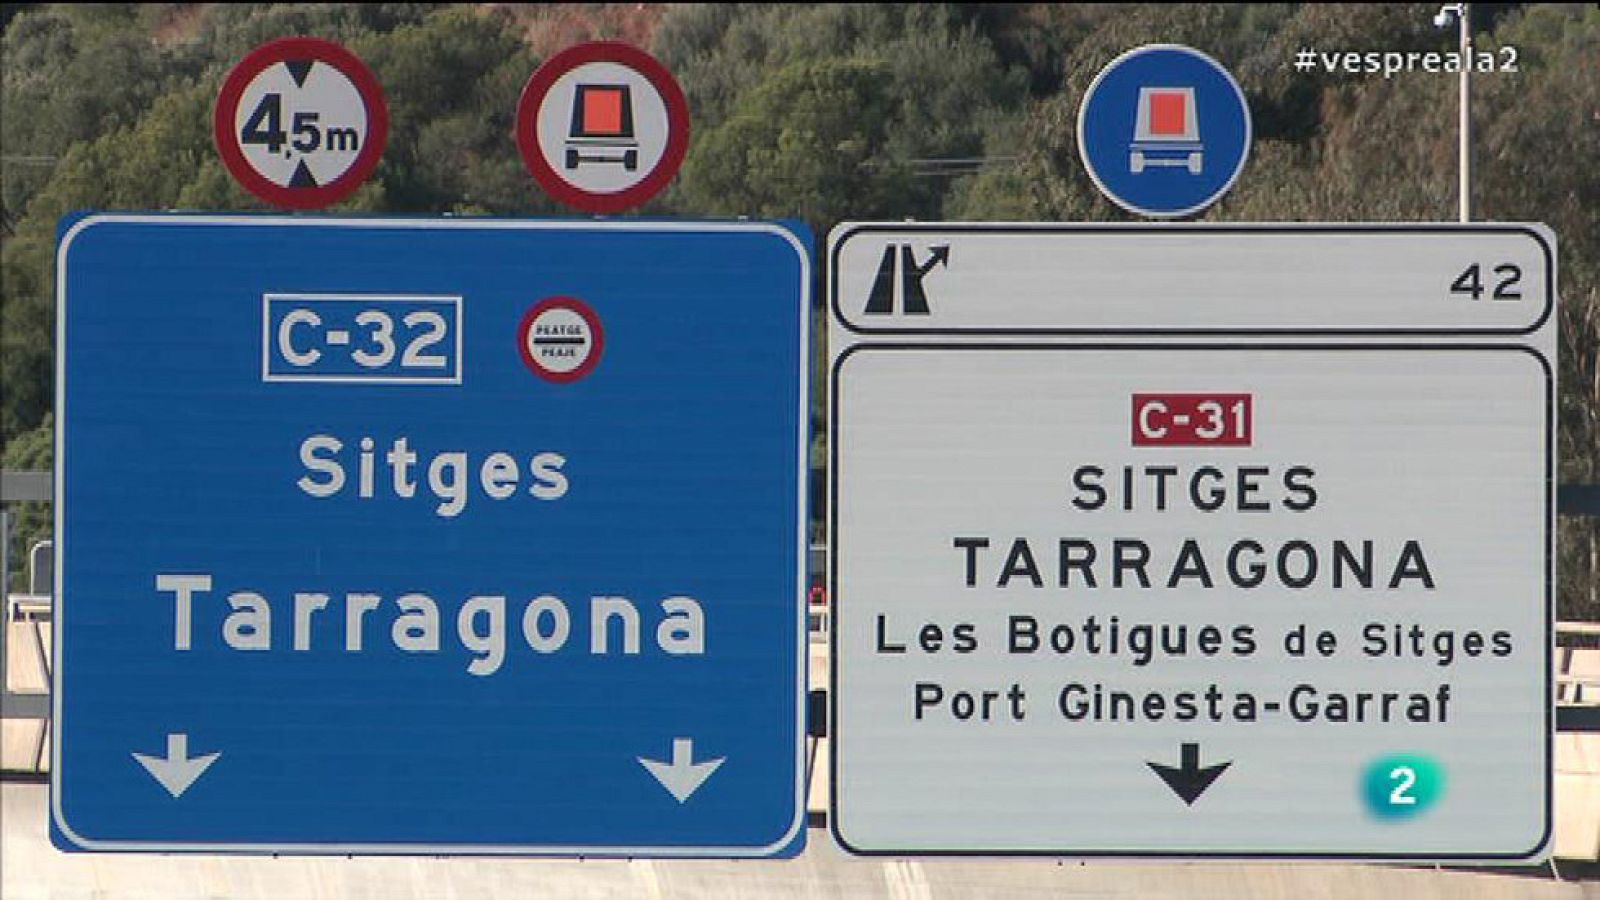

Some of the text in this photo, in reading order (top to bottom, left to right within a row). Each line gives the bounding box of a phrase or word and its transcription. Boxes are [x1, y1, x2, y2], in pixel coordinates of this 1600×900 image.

[1450, 264, 1521, 300] 42
[278, 308, 447, 367] C-32
[536, 325, 581, 335] PEATGE
[541, 348, 576, 357] PEAJE
[1139, 400, 1246, 439] C-31
[297, 435, 568, 516] Sitges
[1072, 466, 1317, 512] SITGES
[954, 538, 1435, 588] TARRAGONA
[157, 575, 705, 675] Tarragona
[878, 615, 1512, 666] Les Botigues de Sitges
[915, 684, 1450, 722] Port Ginesta-Garraf
